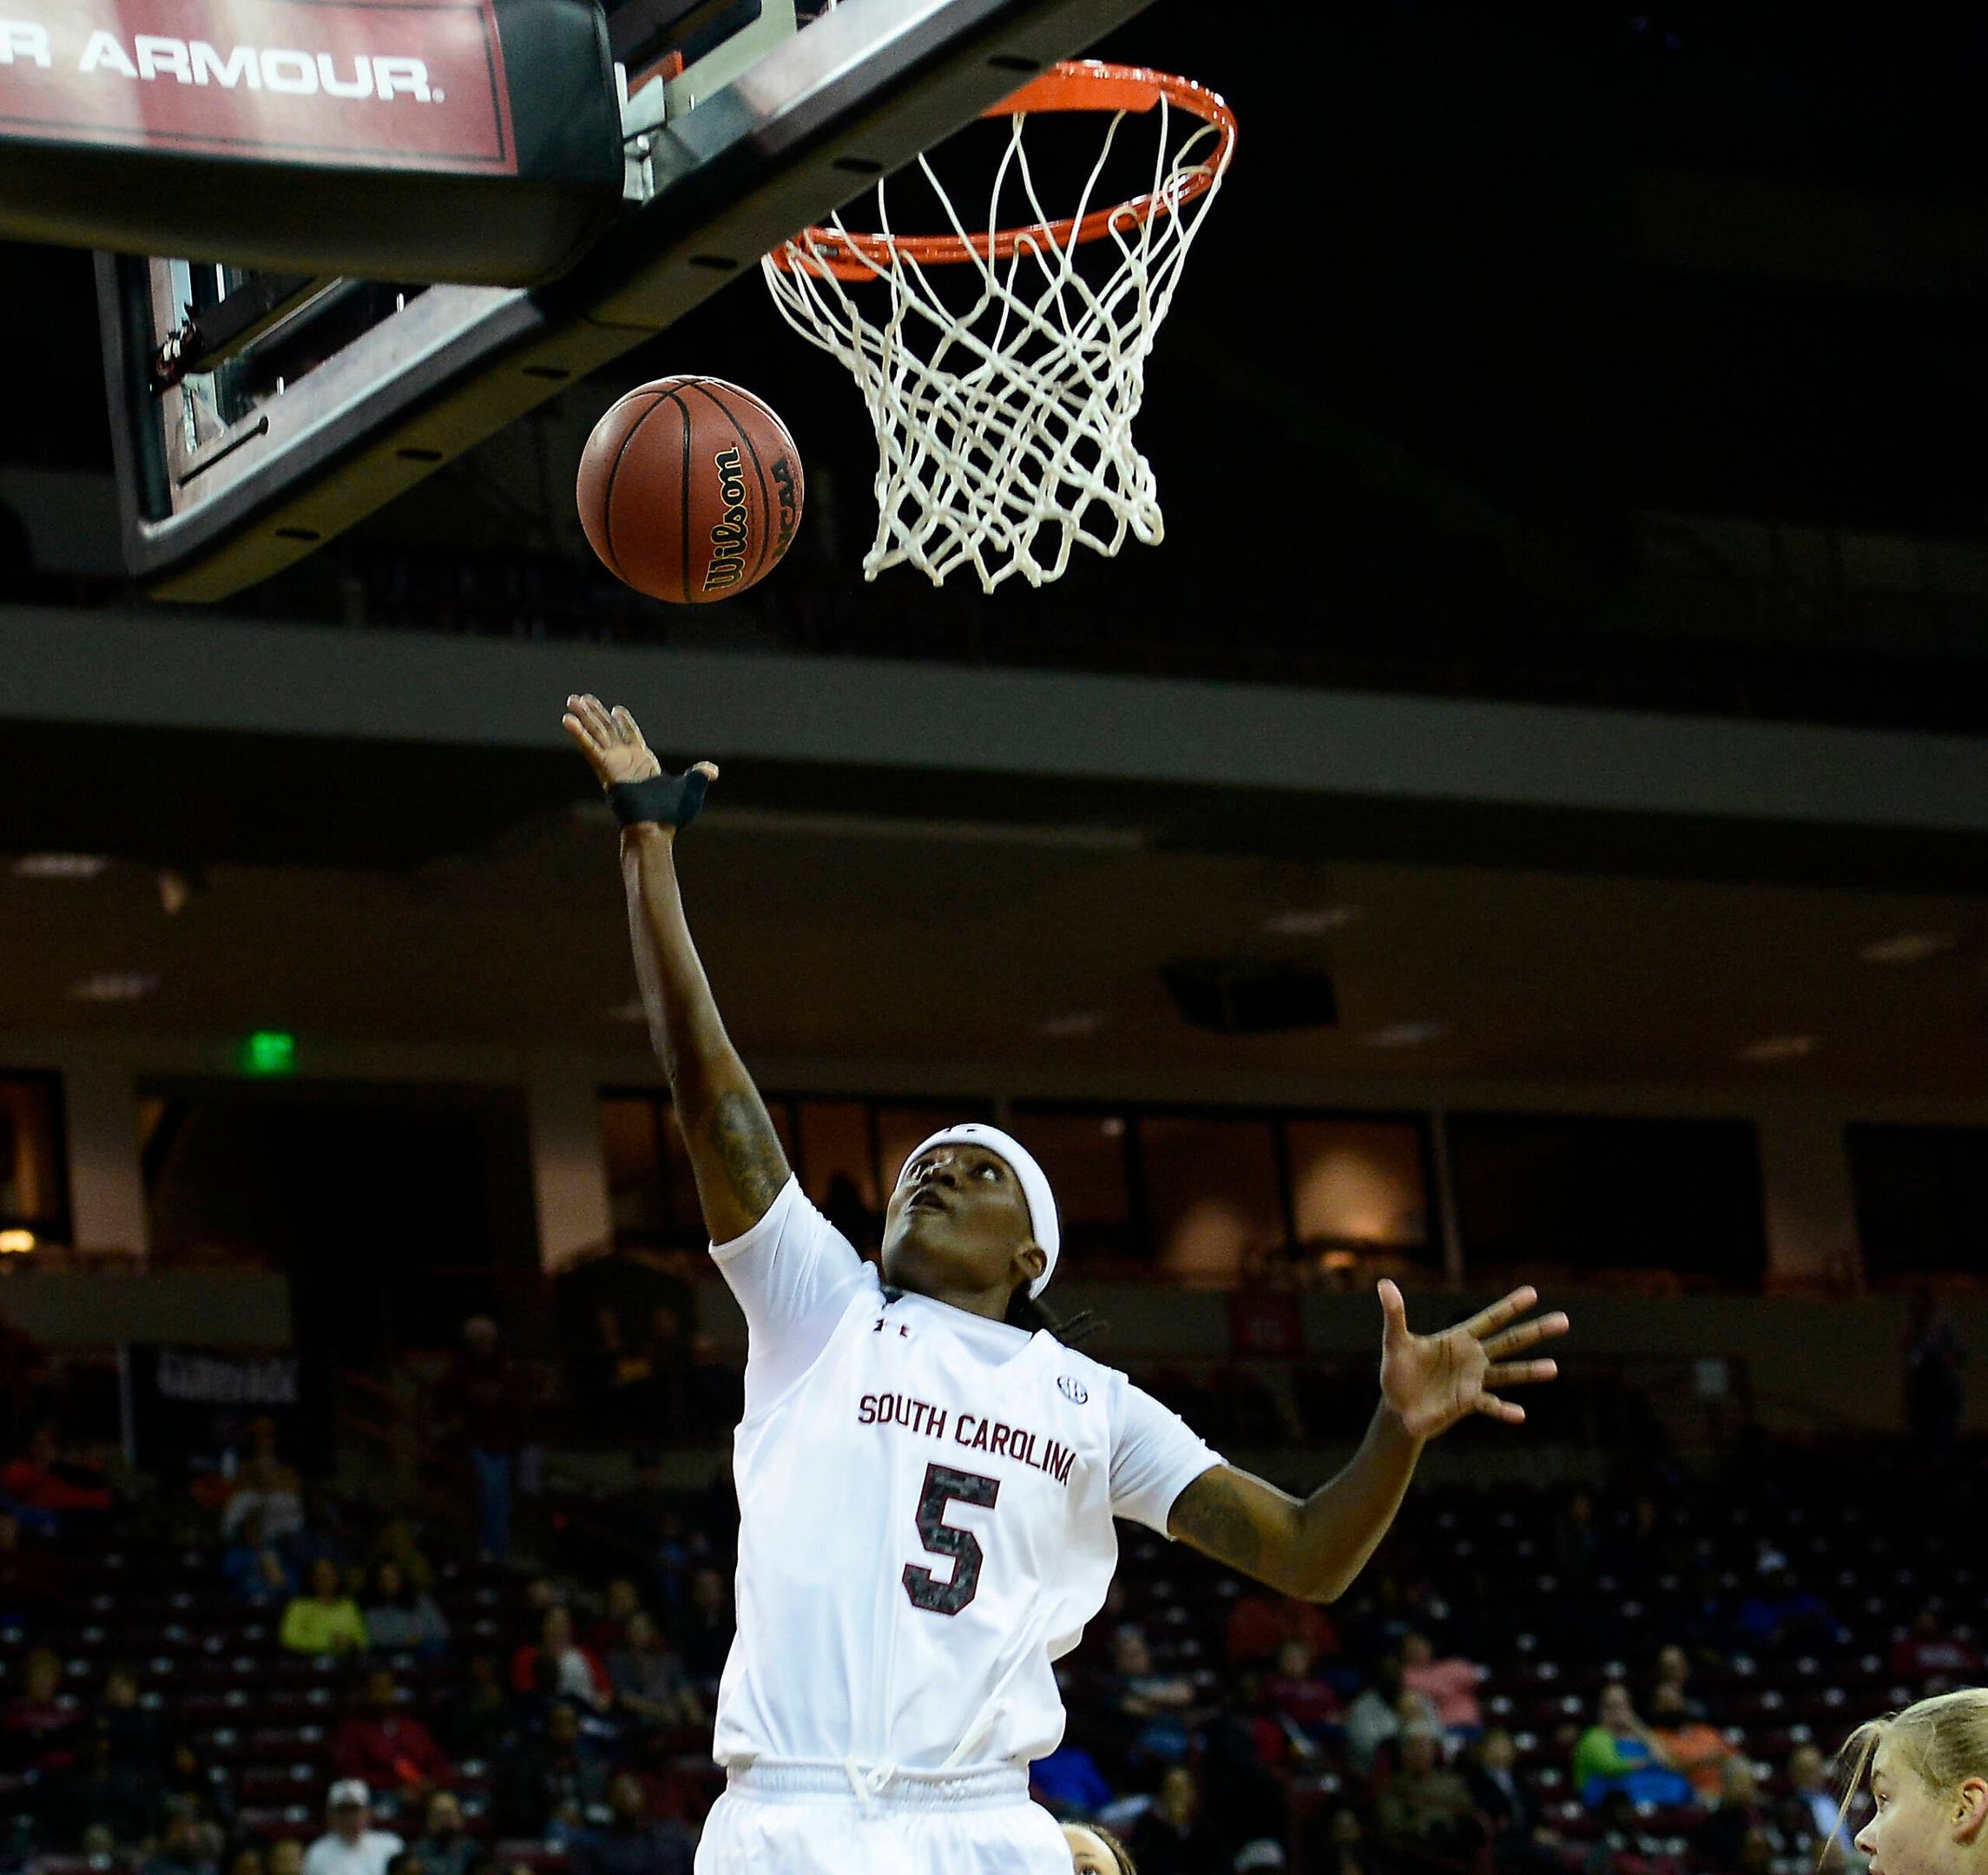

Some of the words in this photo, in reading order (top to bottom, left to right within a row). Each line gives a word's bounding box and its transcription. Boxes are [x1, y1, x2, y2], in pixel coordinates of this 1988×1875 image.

[702, 446, 748, 592] Wilson
[858, 1394, 948, 1439] SOUTH
[955, 1414, 1076, 1487] CAROLINA
[902, 1462, 1001, 1616] 5
